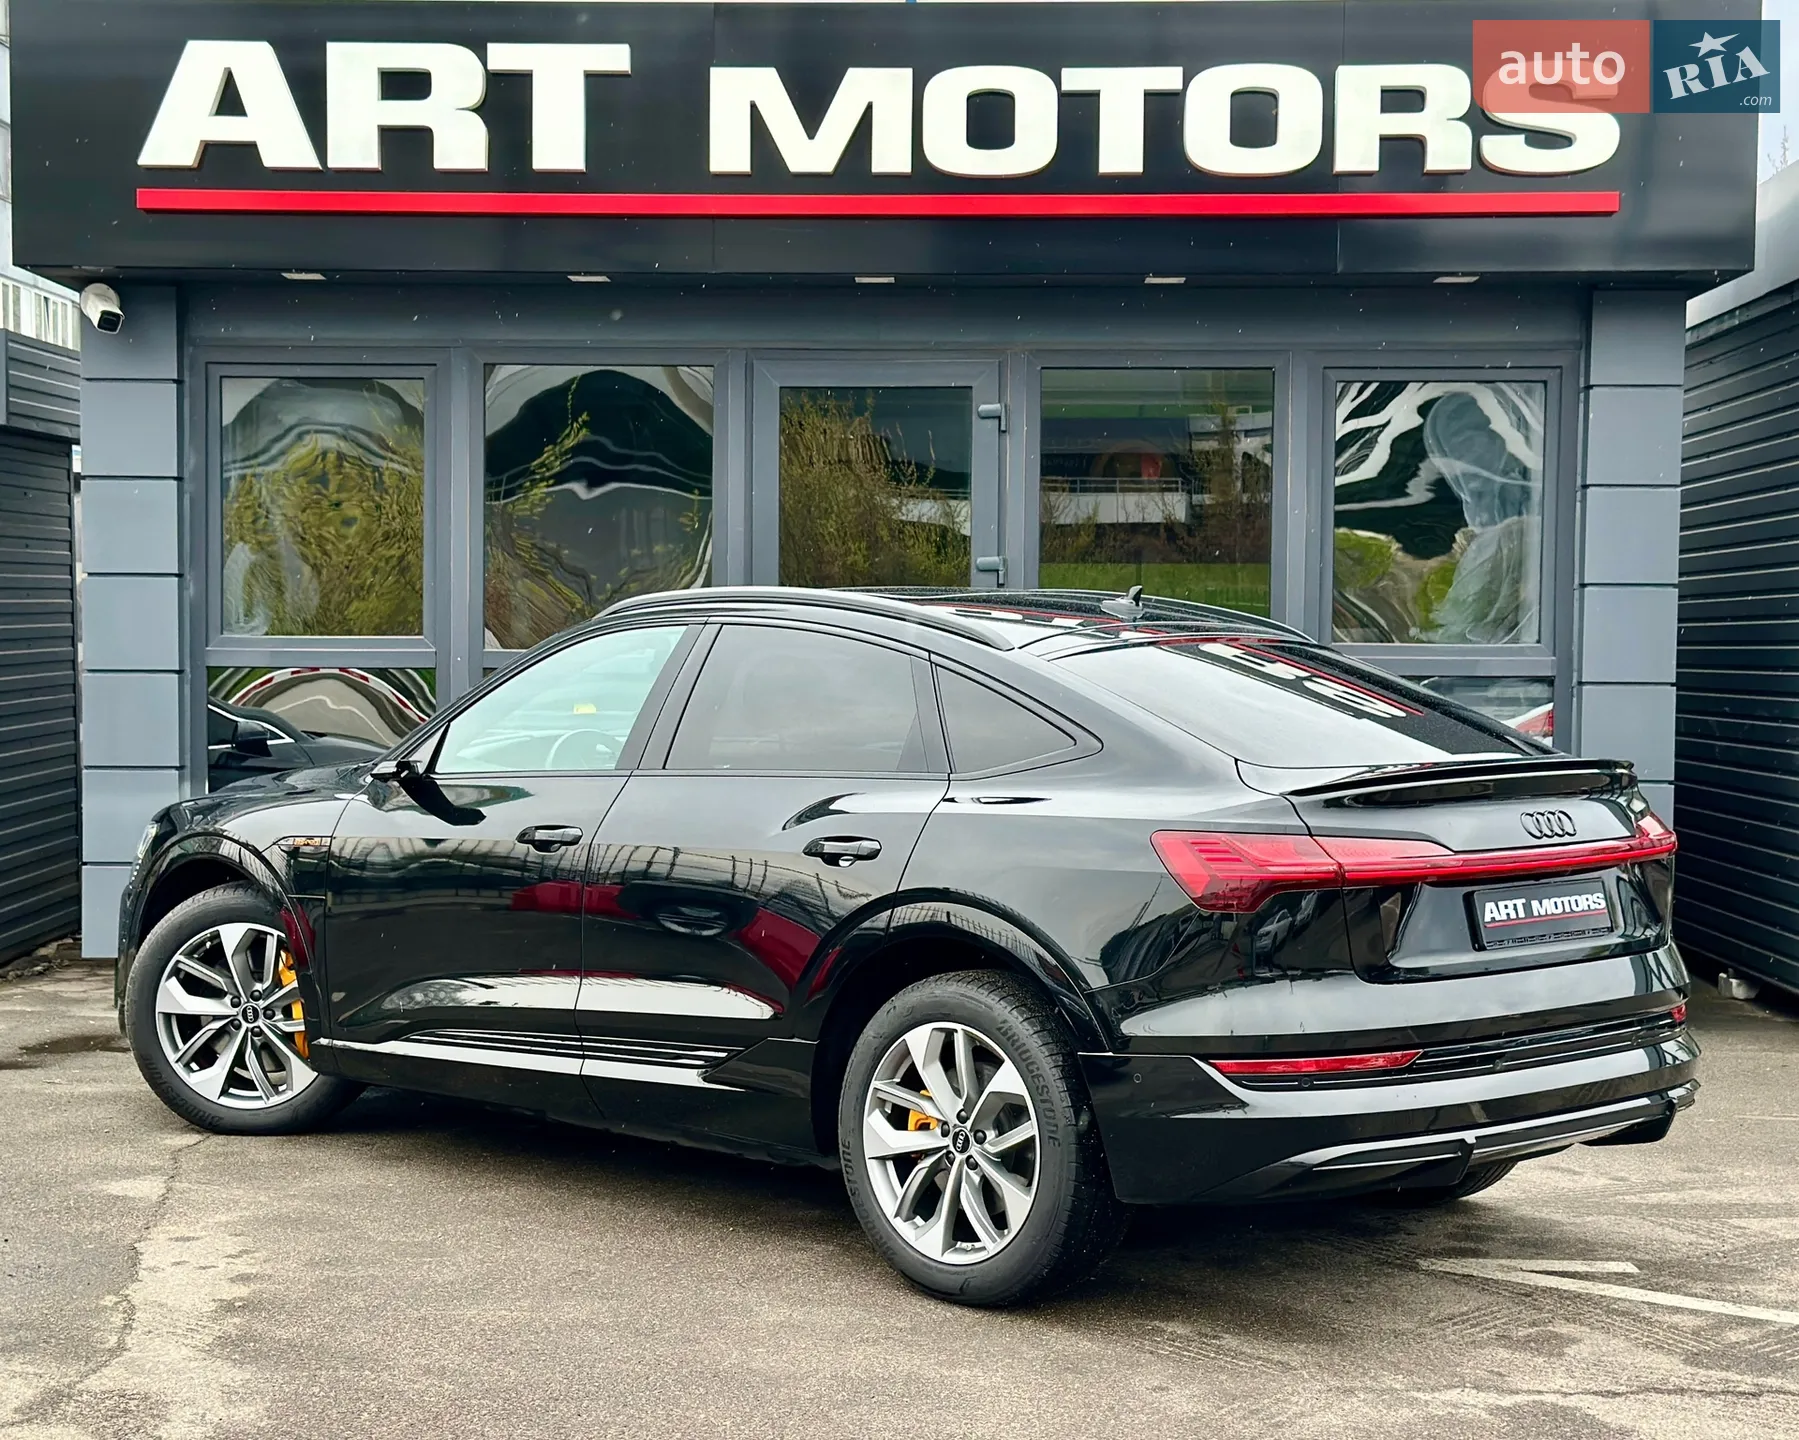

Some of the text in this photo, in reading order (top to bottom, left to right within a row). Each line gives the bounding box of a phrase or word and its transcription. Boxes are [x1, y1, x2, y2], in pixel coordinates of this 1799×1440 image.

[137, 40, 1621, 176] ART MOTORS
[1484, 892, 1606, 922] ART MOTORS
[996, 1020, 1061, 1148] BRIDGESTONE
